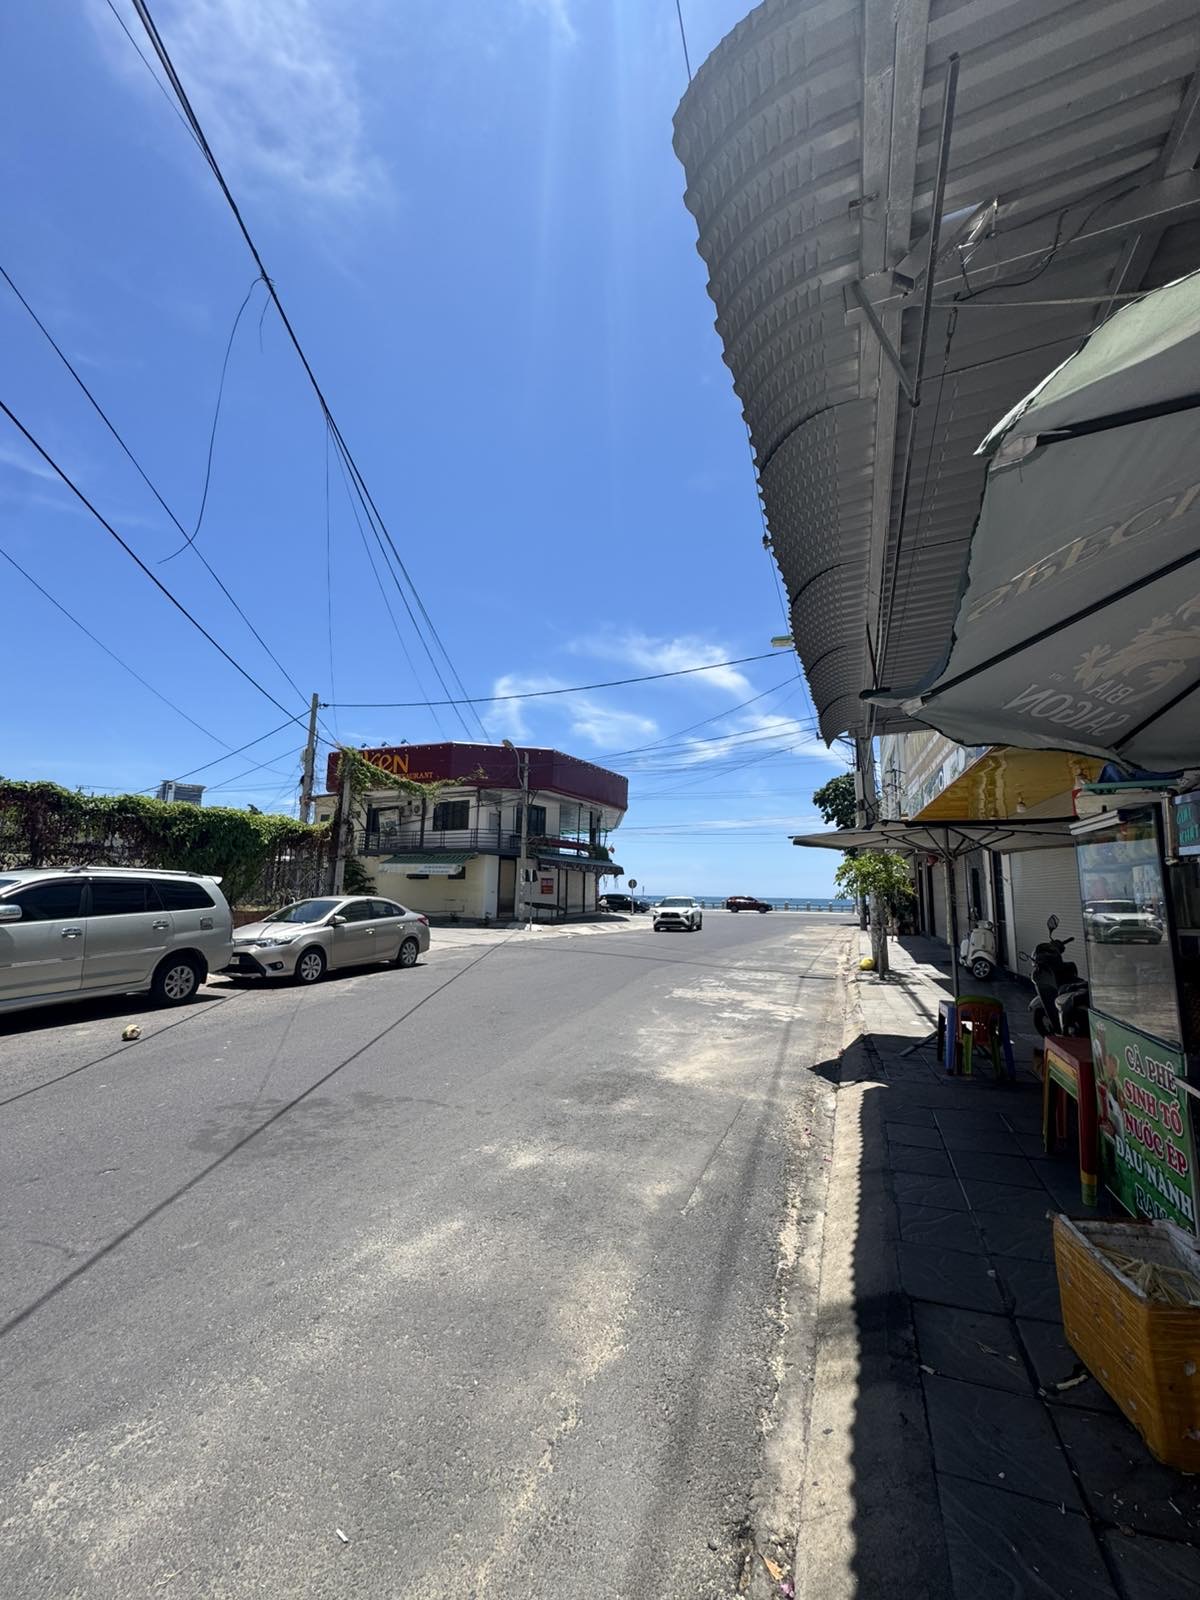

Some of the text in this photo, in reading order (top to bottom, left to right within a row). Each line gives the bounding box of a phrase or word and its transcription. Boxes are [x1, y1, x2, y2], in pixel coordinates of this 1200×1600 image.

[1124, 1044, 1178, 1098] CÀ PHÊ
[1123, 1077, 1183, 1136] SINH TỐ
[1164, 1135, 1188, 1177] ÉP
[1145, 1161, 1194, 1222] NÀNH
